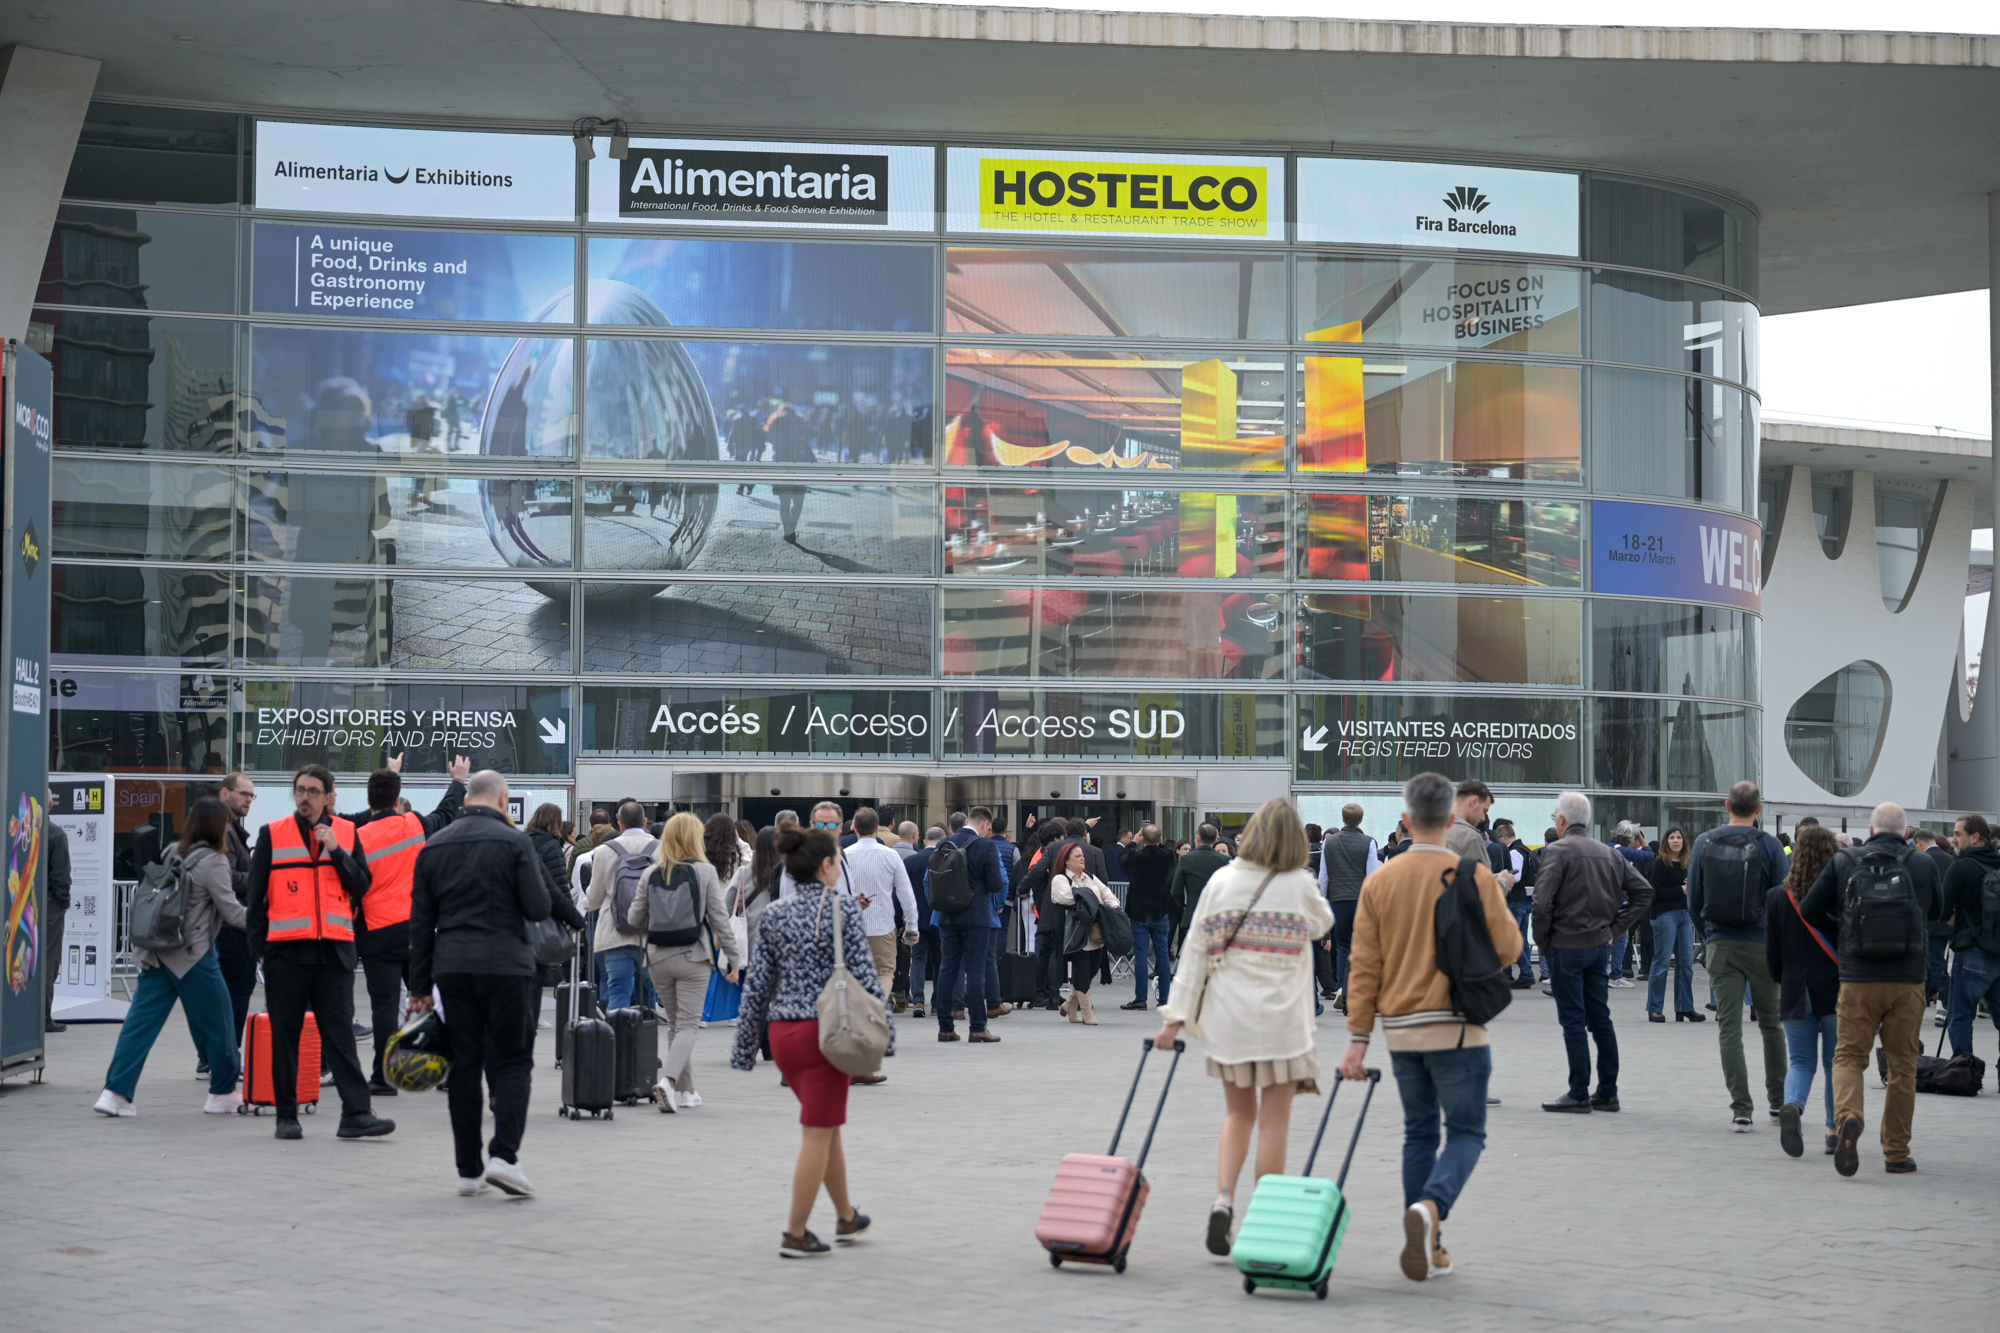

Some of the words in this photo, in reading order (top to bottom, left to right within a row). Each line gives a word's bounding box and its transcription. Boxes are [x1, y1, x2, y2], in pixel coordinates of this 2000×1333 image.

[275, 161, 378, 182] Alimentaria
[415, 167, 513, 188] Exhibitions
[631, 158, 877, 201] Alimentaria
[994, 170, 1258, 212] HOSTELCO
[630, 201, 690, 211] International
[692, 202, 719, 213] Food,
[722, 203, 752, 213] Drinks
[754, 204, 762, 213] &
[764, 205, 789, 214] Food
[791, 205, 827, 215] Service
[829, 206, 876, 217] Exhibition
[993, 211, 1018, 222] THE
[1023, 212, 1065, 223] HOTEL
[1070, 213, 1079, 223] &
[1084, 213, 1167, 226] RESTAURANT
[1172, 216, 1214, 227] TRADE
[1219, 217, 1258, 228] SHOW
[1416, 215, 1443, 231] Fira
[1448, 217, 1517, 236] Barcelona
[310, 234, 324, 250] A
[330, 236, 394, 254] unique
[311, 254, 363, 273] Food,
[369, 256, 428, 273] Drinks
[433, 259, 467, 275] and
[311, 272, 426, 295] Gastronomy
[1447, 279, 1511, 300] FOCUS
[1516, 275, 1544, 292] ON
[311, 291, 415, 312] Experience
[1422, 295, 1544, 324] HOSPITALITY
[1454, 315, 1544, 339] BUSINESS
[1622, 534, 1664, 551] 18-21
[1608, 550, 1641, 563] Marzo
[1642, 552, 1647, 563] /
[1648, 553, 1676, 565] March
[1699, 525, 1760, 597] WELC
[15, 657, 34, 684] HALL
[33, 662, 39, 685] 2
[183, 699, 223, 708] Alimentaria
[258, 708, 406, 728] EXPOSITORES
[412, 710, 426, 728] Y
[432, 711, 517, 728] PRENSA
[650, 704, 761, 735] Accés
[780, 705, 796, 735] /
[804, 706, 928, 738] Acceso
[944, 707, 958, 737] /
[976, 708, 1096, 738] Access
[1107, 709, 1186, 739] SUD
[256, 728, 377, 747] EXHIBITORS
[379, 730, 425, 748] AND
[429, 731, 497, 749] PRESS
[1337, 720, 1446, 738] VISITANTES
[1450, 722, 1577, 741] ACREDITADOS
[1337, 740, 1451, 758] REGISTERED
[1456, 741, 1534, 759] VISITORS
[76, 790, 83, 802] A
[92, 790, 98, 802] H
[119, 789, 161, 805] Spain
[511, 805, 518, 815] H
